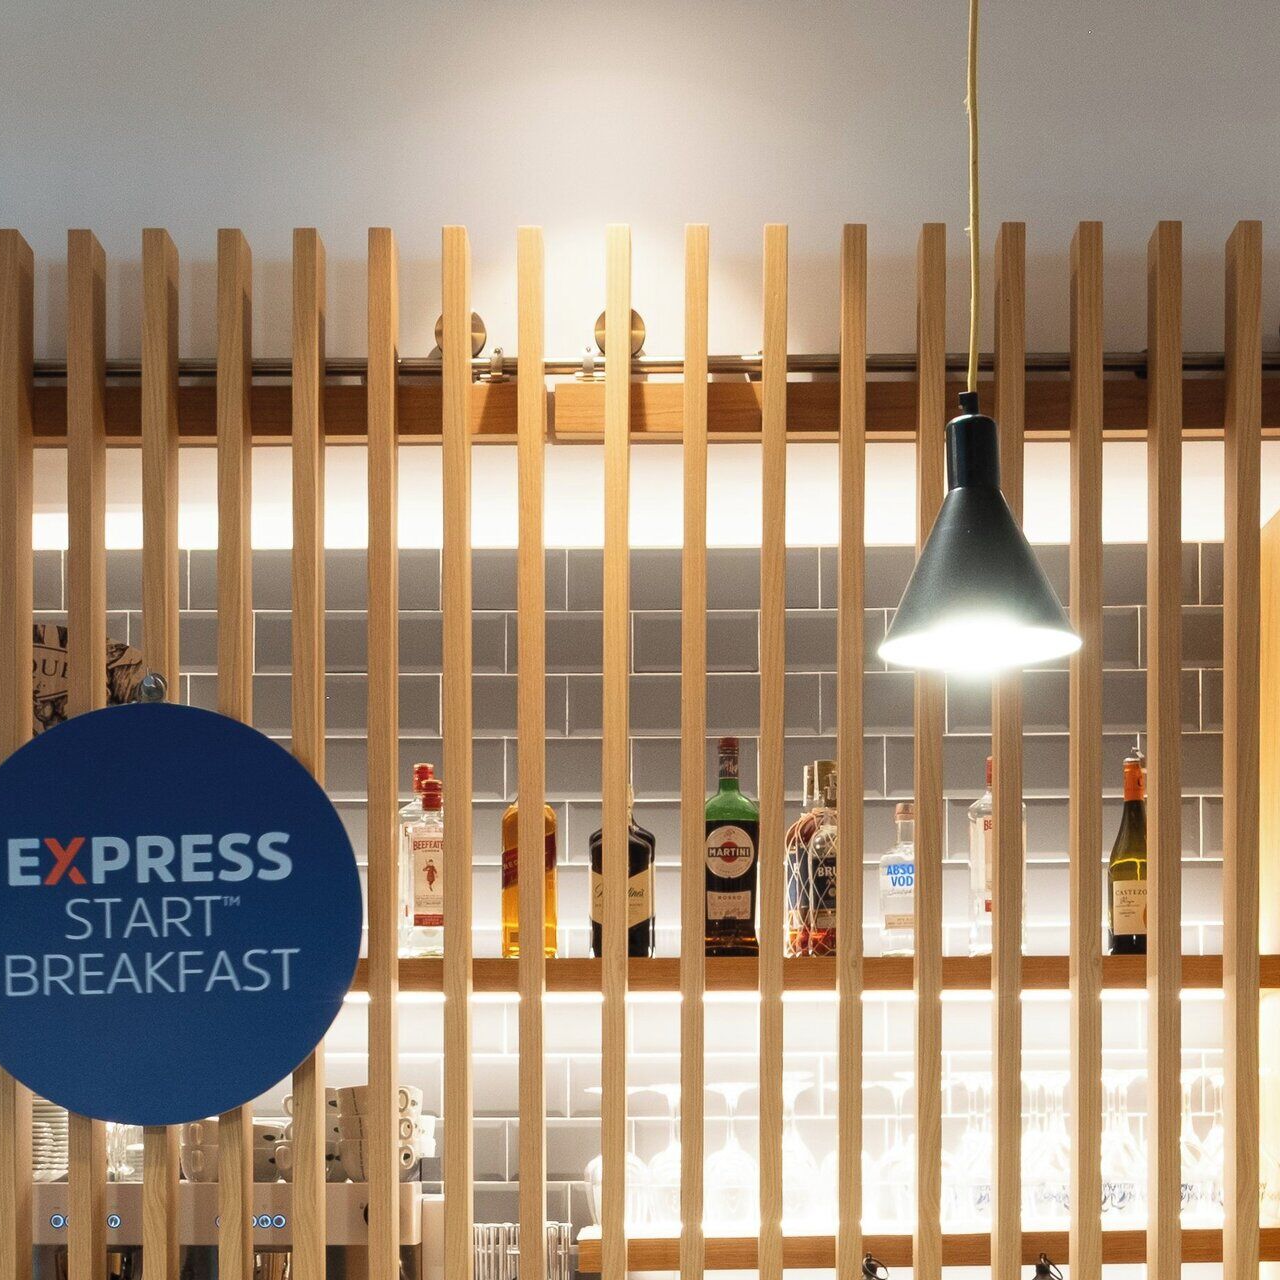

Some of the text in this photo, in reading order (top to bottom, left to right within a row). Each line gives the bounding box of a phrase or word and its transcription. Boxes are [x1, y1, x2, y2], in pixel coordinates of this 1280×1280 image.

[708, 847, 750, 857] MARTINI
[7, 832, 293, 886] EXPRESS
[886, 864, 915, 876] ABSO
[891, 876, 914, 887] VOD
[5, 948, 301, 997] BREAKFAST
